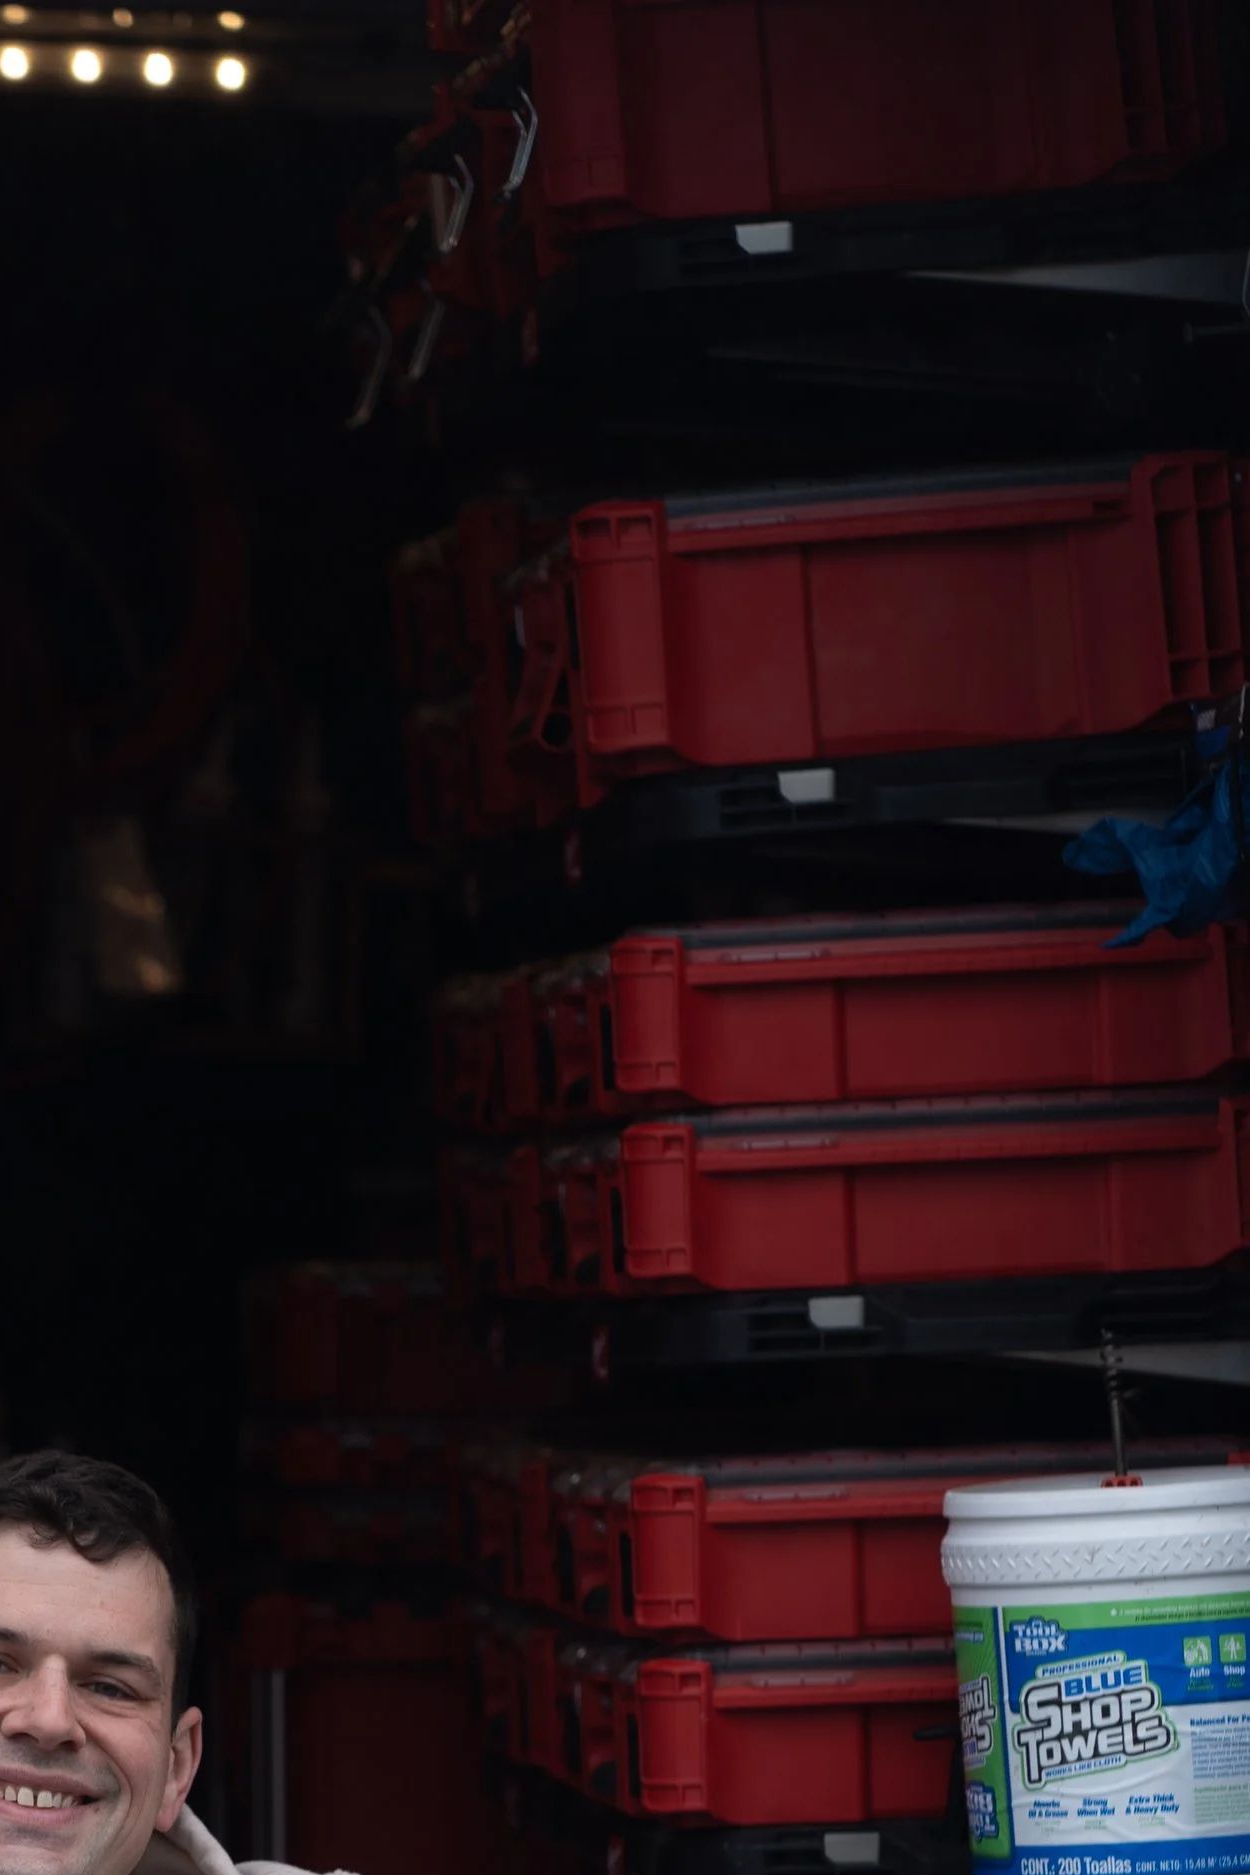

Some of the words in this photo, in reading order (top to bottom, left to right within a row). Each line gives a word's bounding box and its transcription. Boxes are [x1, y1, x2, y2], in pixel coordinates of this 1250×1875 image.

[1013, 1623, 1059, 1637] TOOL
[1015, 1634, 1066, 1653] BOX
[1042, 1655, 1120, 1676] PROFESSIONAL
[1190, 1666, 1210, 1678] Auto
[1223, 1665, 1245, 1677] Shop
[1064, 1666, 1143, 1697] BLUE
[1026, 1685, 1153, 1739] SHOP
[1190, 1715, 1225, 1726] Balanced
[1227, 1714, 1239, 1724] For
[1020, 1717, 1169, 1781] TOWELS
[1045, 1766, 1072, 1778] WORKS
[1074, 1761, 1092, 1772] LIKE
[1093, 1755, 1122, 1767] CLOTH
[1083, 1797, 1108, 1808] Strong
[1129, 1795, 1150, 1804] Extra
[1153, 1793, 1174, 1803] Thick
[1077, 1808, 1098, 1816] When
[1100, 1806, 1115, 1816] Wet
[1134, 1805, 1158, 1815] Heavy
[1160, 1803, 1180, 1814] Duty
[1058, 1857, 1081, 1875] 200
[1084, 1855, 1132, 1875] Toallas
